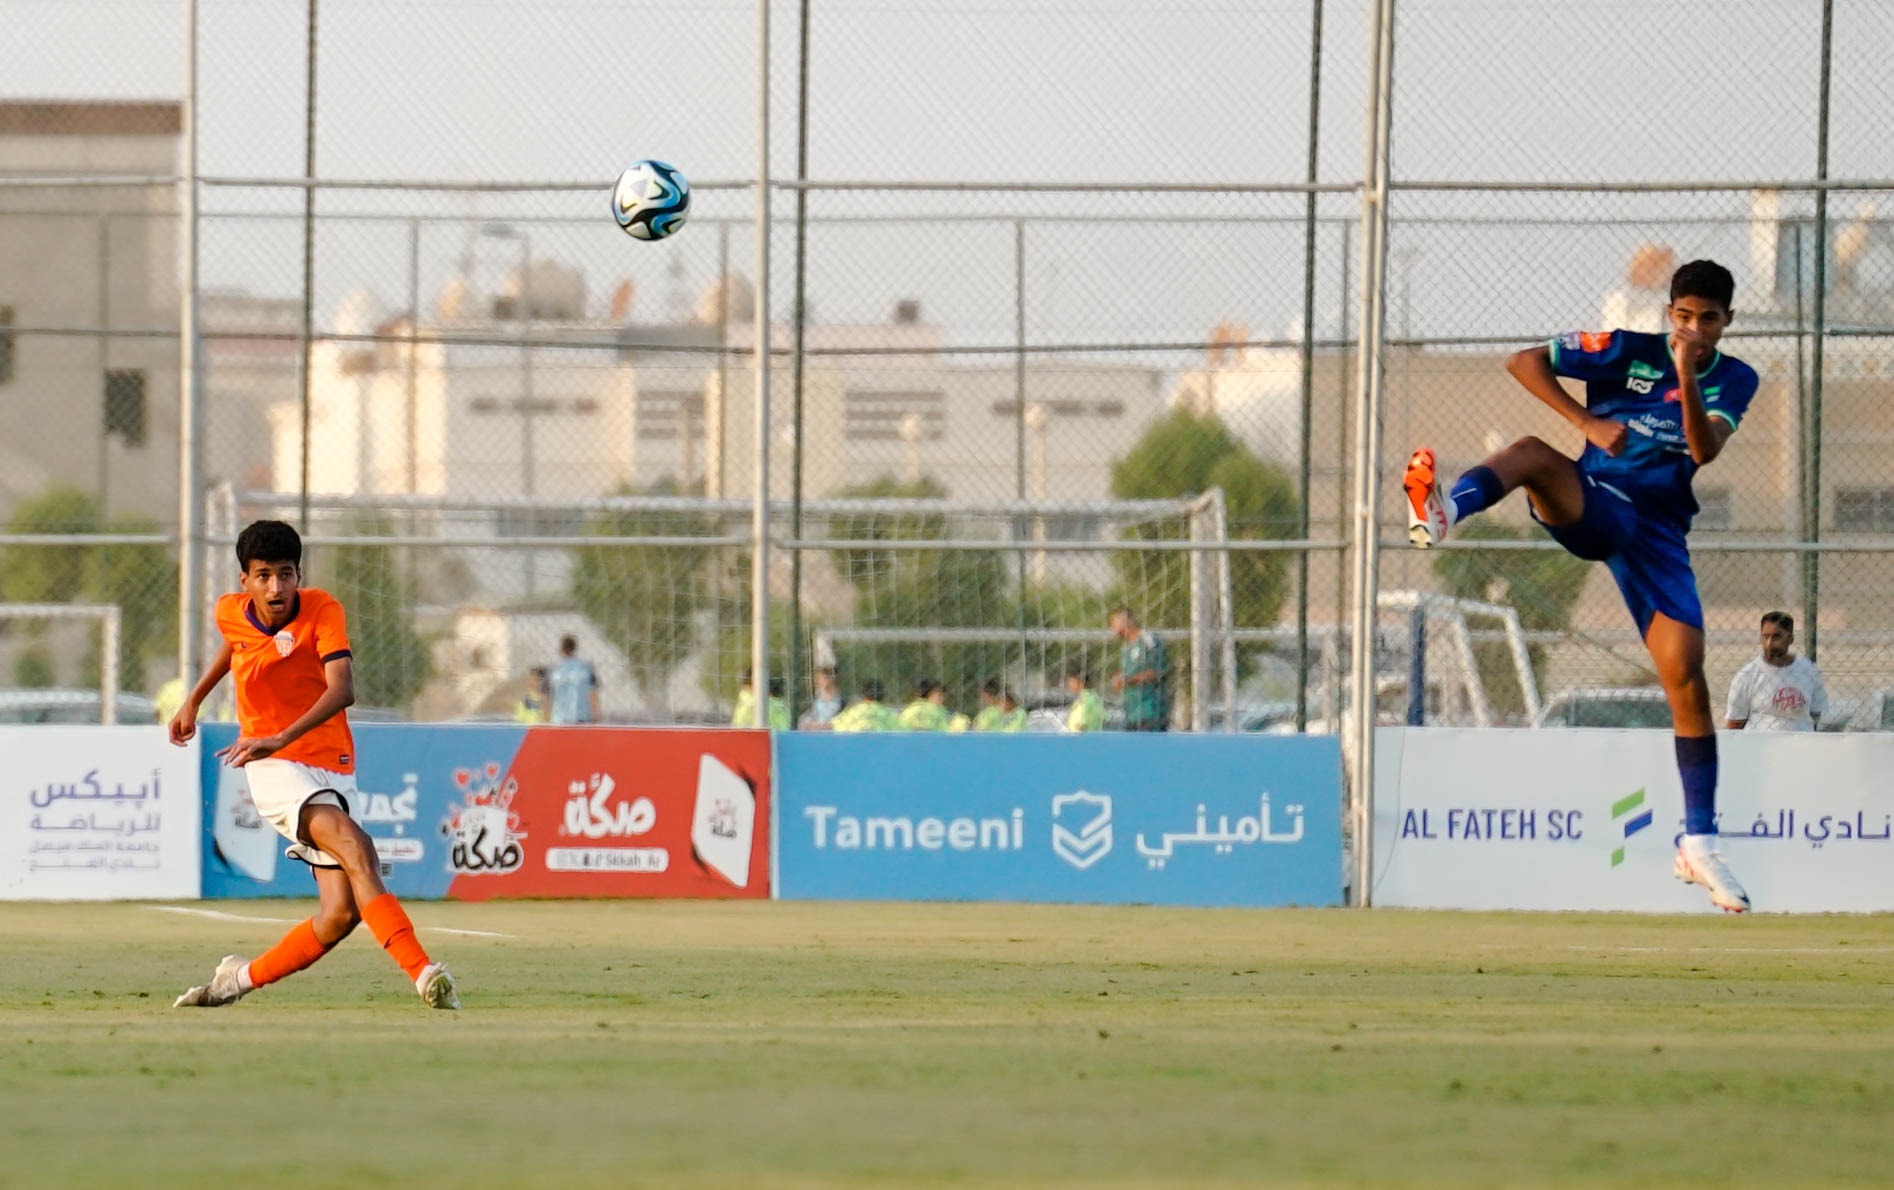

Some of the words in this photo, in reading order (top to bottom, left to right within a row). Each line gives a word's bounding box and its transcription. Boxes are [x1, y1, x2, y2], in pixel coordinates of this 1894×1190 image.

[804, 806, 1024, 849] Tameeni
[1136, 791, 1304, 869] تأميني
[1402, 808, 1438, 839] AL
[1448, 808, 1536, 840] FATEH
[1547, 808, 1583, 841] SC
[1804, 809, 1891, 848] نادي
